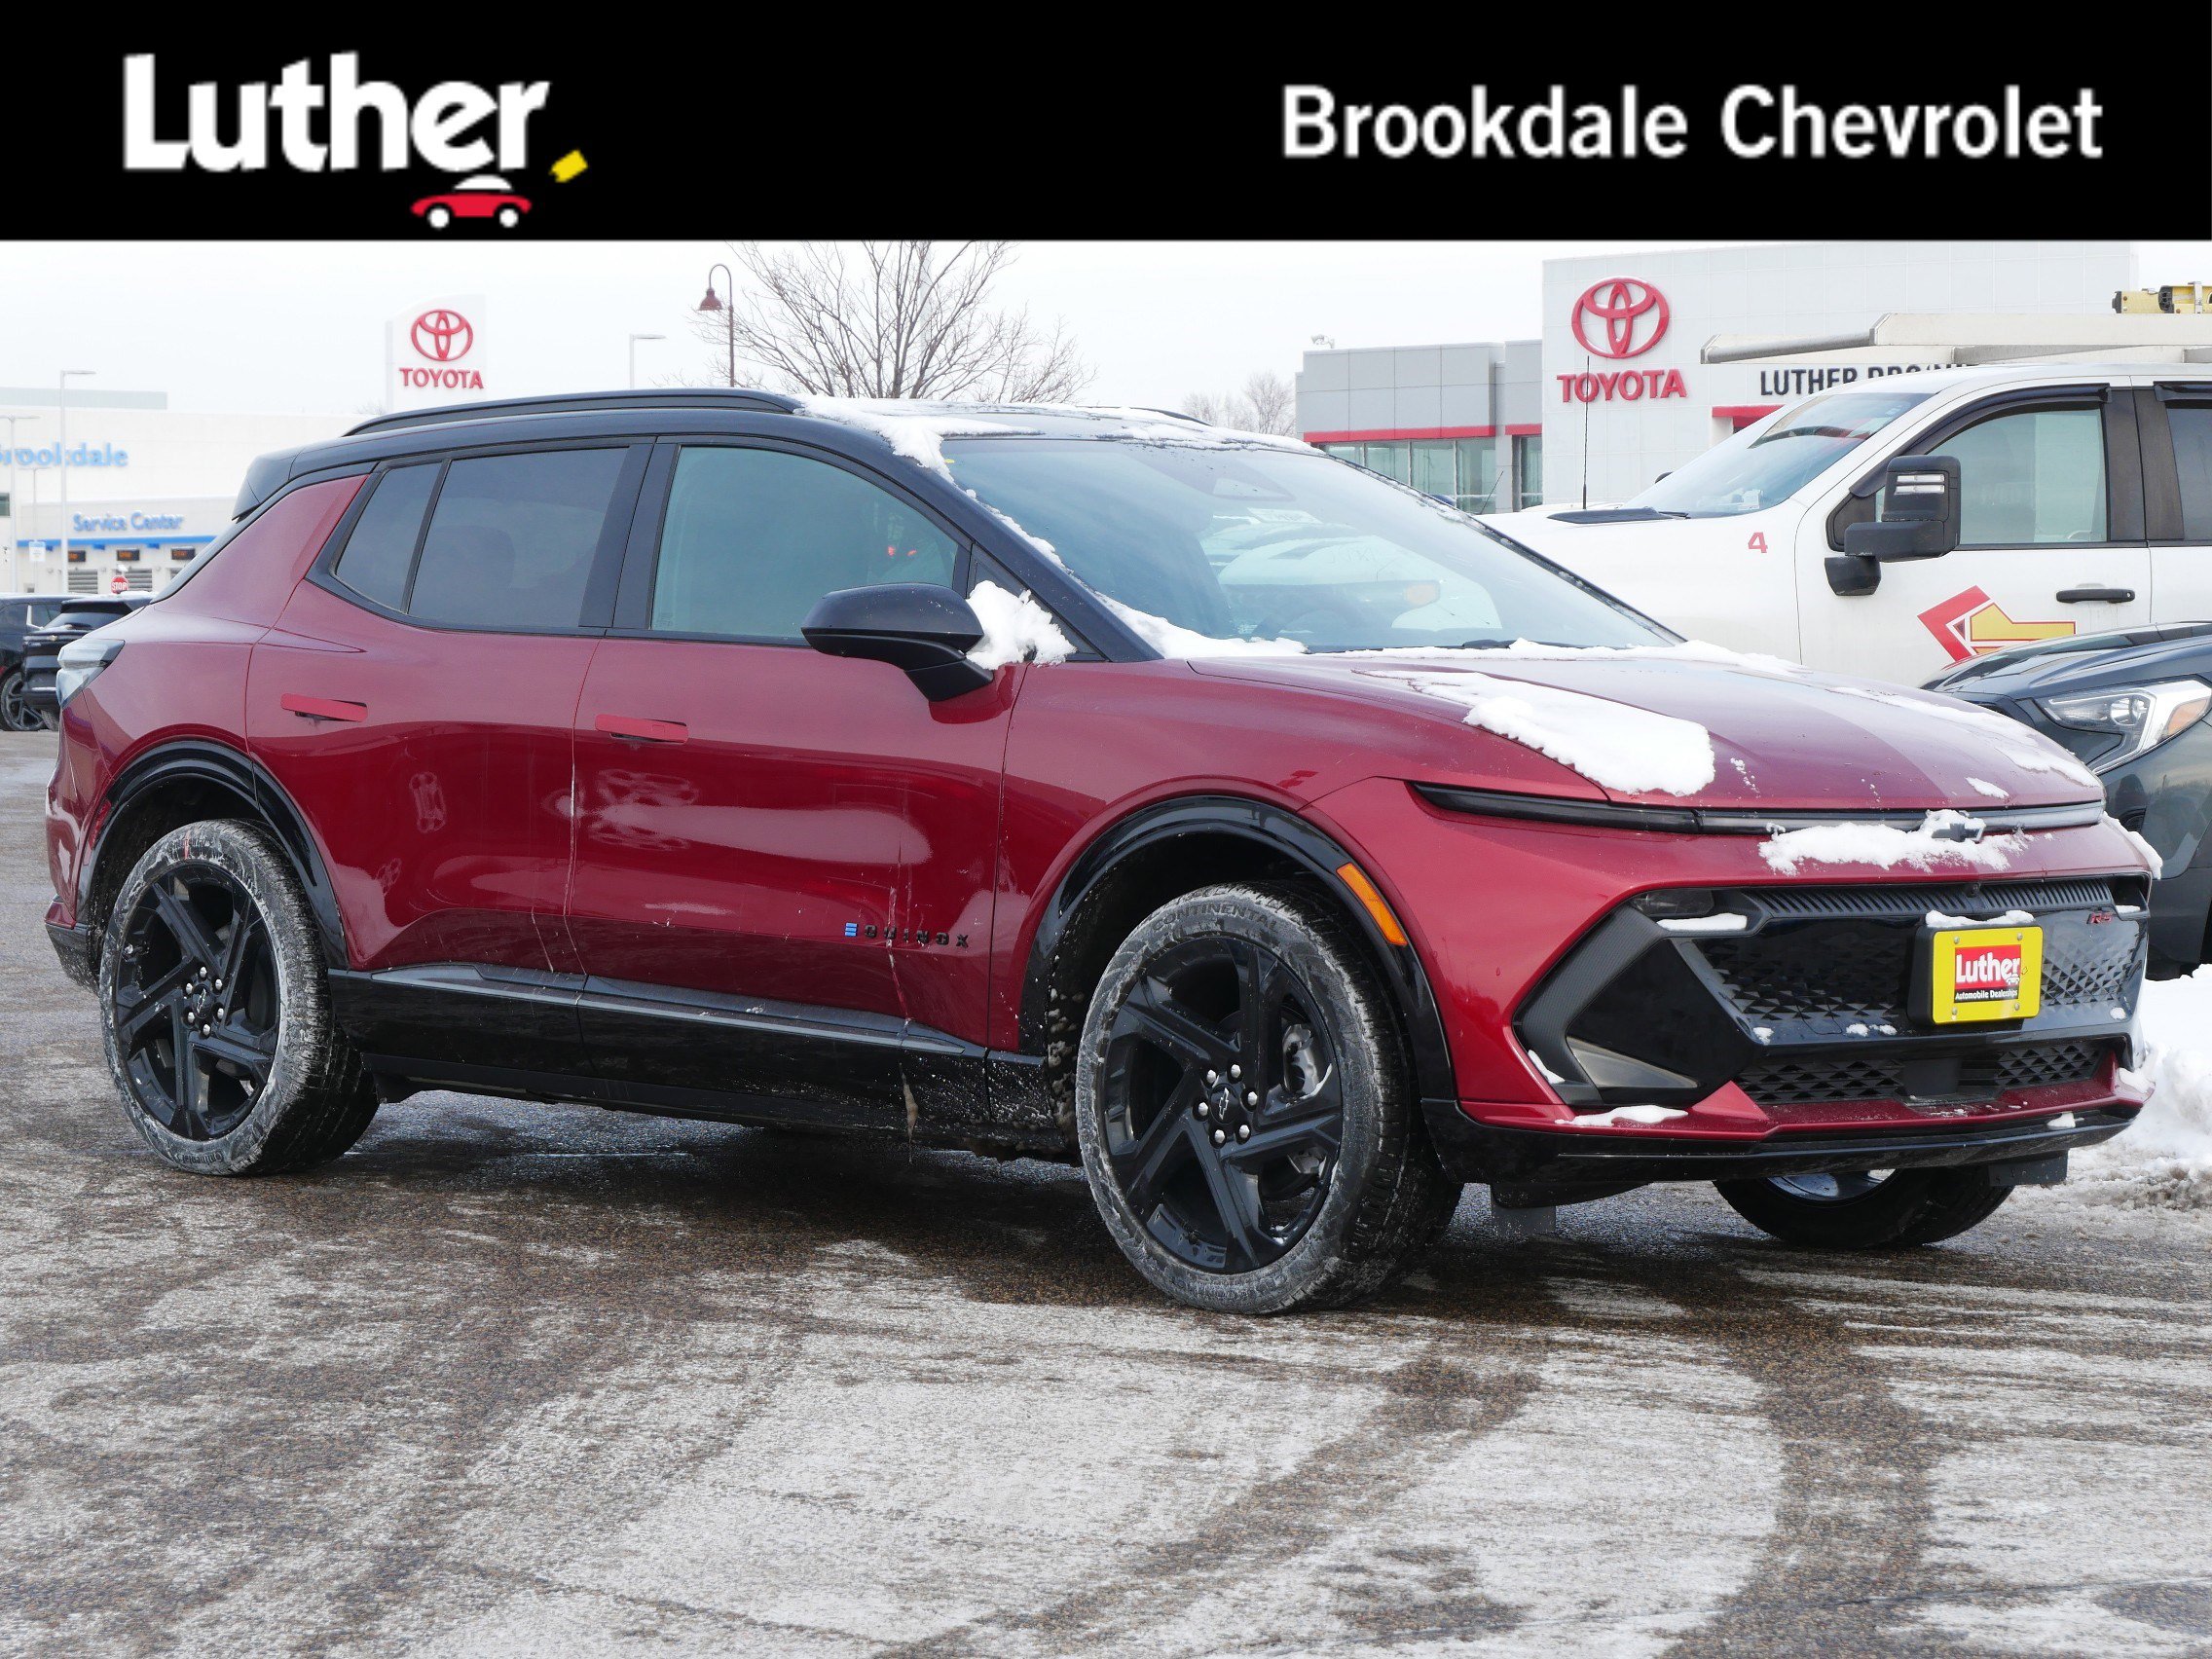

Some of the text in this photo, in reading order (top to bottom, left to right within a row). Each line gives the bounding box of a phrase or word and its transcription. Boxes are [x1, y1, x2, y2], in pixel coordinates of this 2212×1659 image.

[399, 367, 484, 389] TOYOTA
[1557, 368, 1687, 402] TOYOTA
[1760, 367, 1858, 396] LUTHER
[0, 442, 129, 466] rookdale
[73, 511, 184, 532] Service Center
[1748, 533, 1768, 554] 4
[112, 581, 128, 591] STOP
[1956, 952, 2020, 983] Luther
[1955, 988, 2018, 1001] Automobile Dealerships
